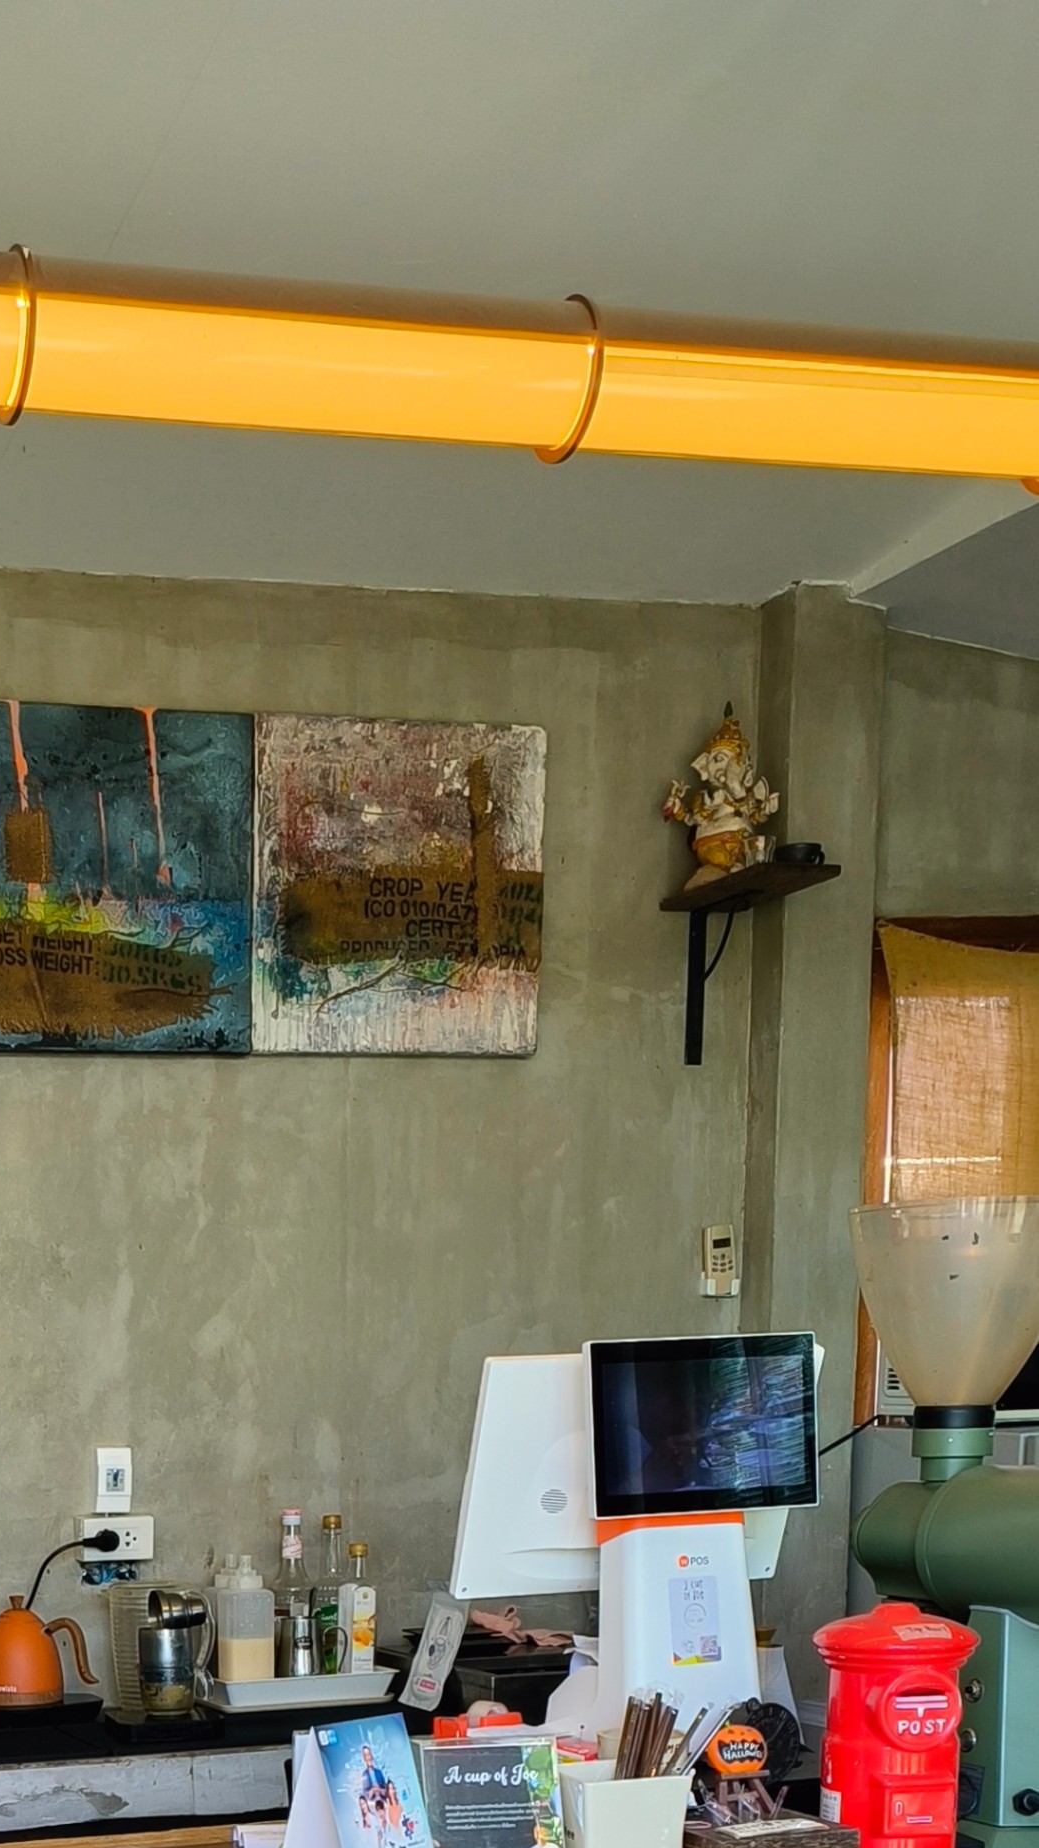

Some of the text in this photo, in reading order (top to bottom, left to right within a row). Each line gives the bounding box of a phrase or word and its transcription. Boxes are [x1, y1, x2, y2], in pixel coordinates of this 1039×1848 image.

[369, 877, 424, 898] CROP
[436, 877, 477, 901] YEA
[31, 951, 101, 976] WEIGHT:
[690, 1556, 709, 1565] POS
[897, 1719, 947, 1735] POST
[729, 1742, 760, 1750] HAPPY
[443, 1763, 539, 1786] A cup of Joe
